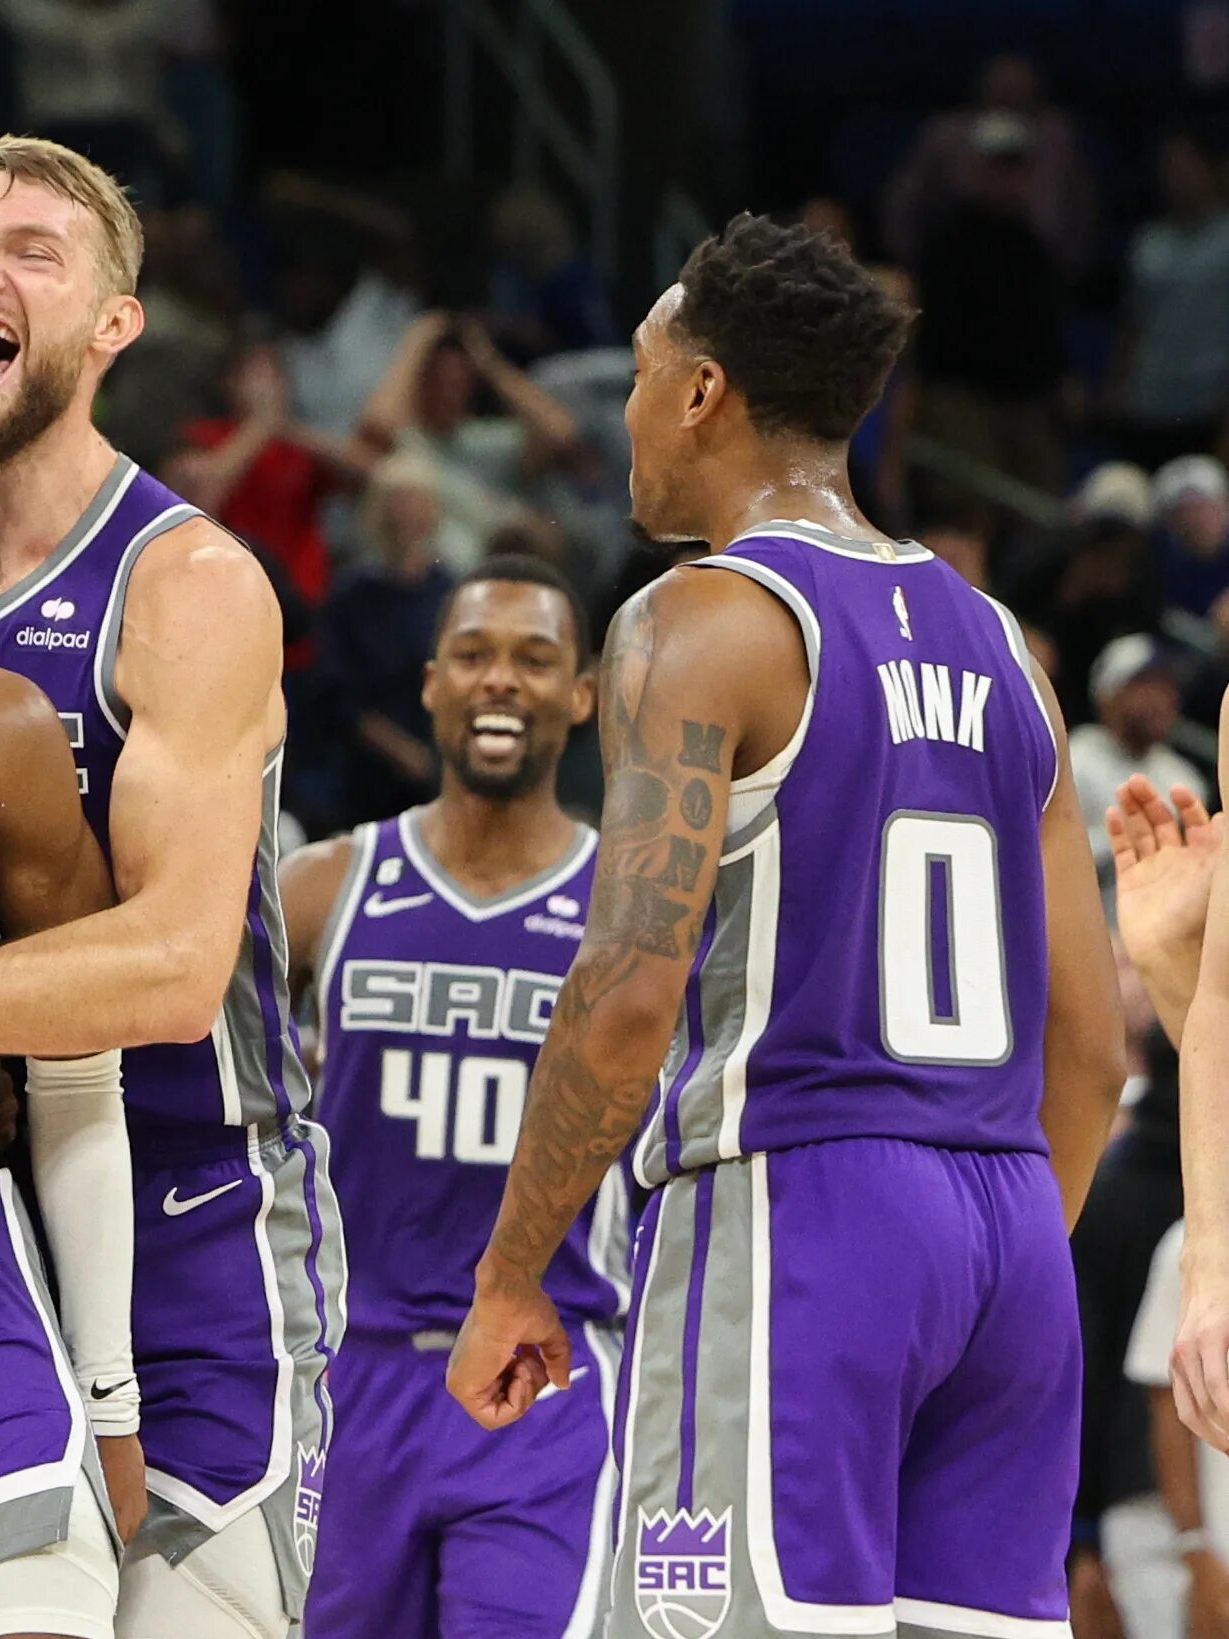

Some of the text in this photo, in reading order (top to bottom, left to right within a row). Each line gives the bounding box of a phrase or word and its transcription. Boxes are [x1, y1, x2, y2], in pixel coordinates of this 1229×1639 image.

[16, 627, 90, 650] dialpad
[877, 659, 993, 753] MONK
[878, 808, 1014, 1067] 0
[380, 1049, 529, 1166] 40
[638, 1561, 726, 1590] SAC
